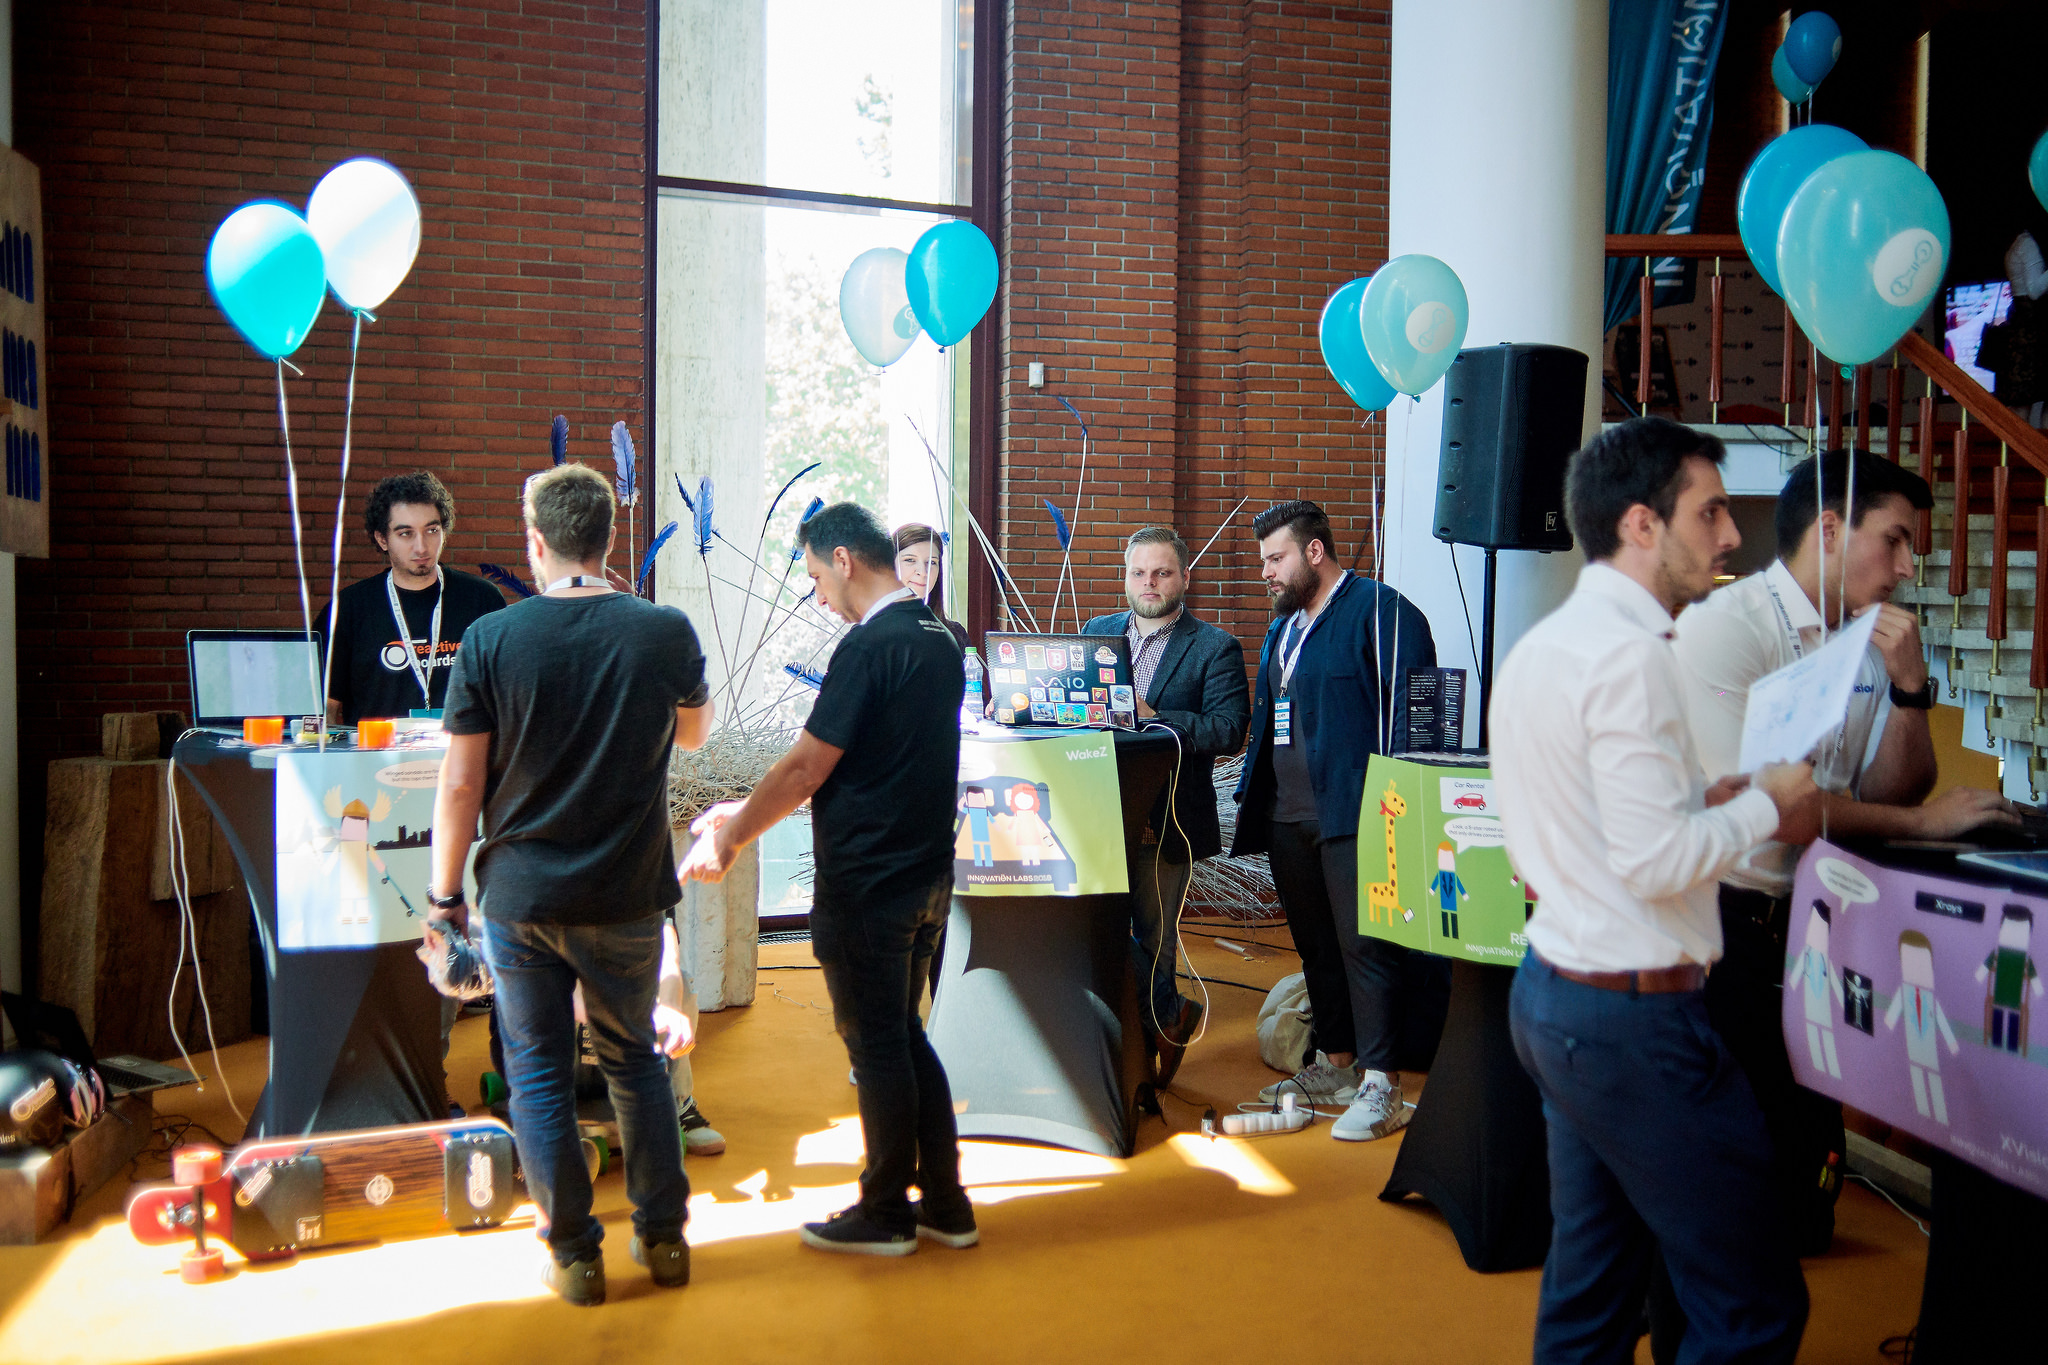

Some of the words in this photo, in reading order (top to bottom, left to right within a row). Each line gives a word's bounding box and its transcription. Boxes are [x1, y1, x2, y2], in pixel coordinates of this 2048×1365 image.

[417, 654, 457, 668] oards
[1035, 676, 1085, 690] VAIO
[1066, 746, 1108, 761] WakeZ
[967, 873, 1012, 884] INNOVATION
[1935, 898, 1963, 914] Xrays
